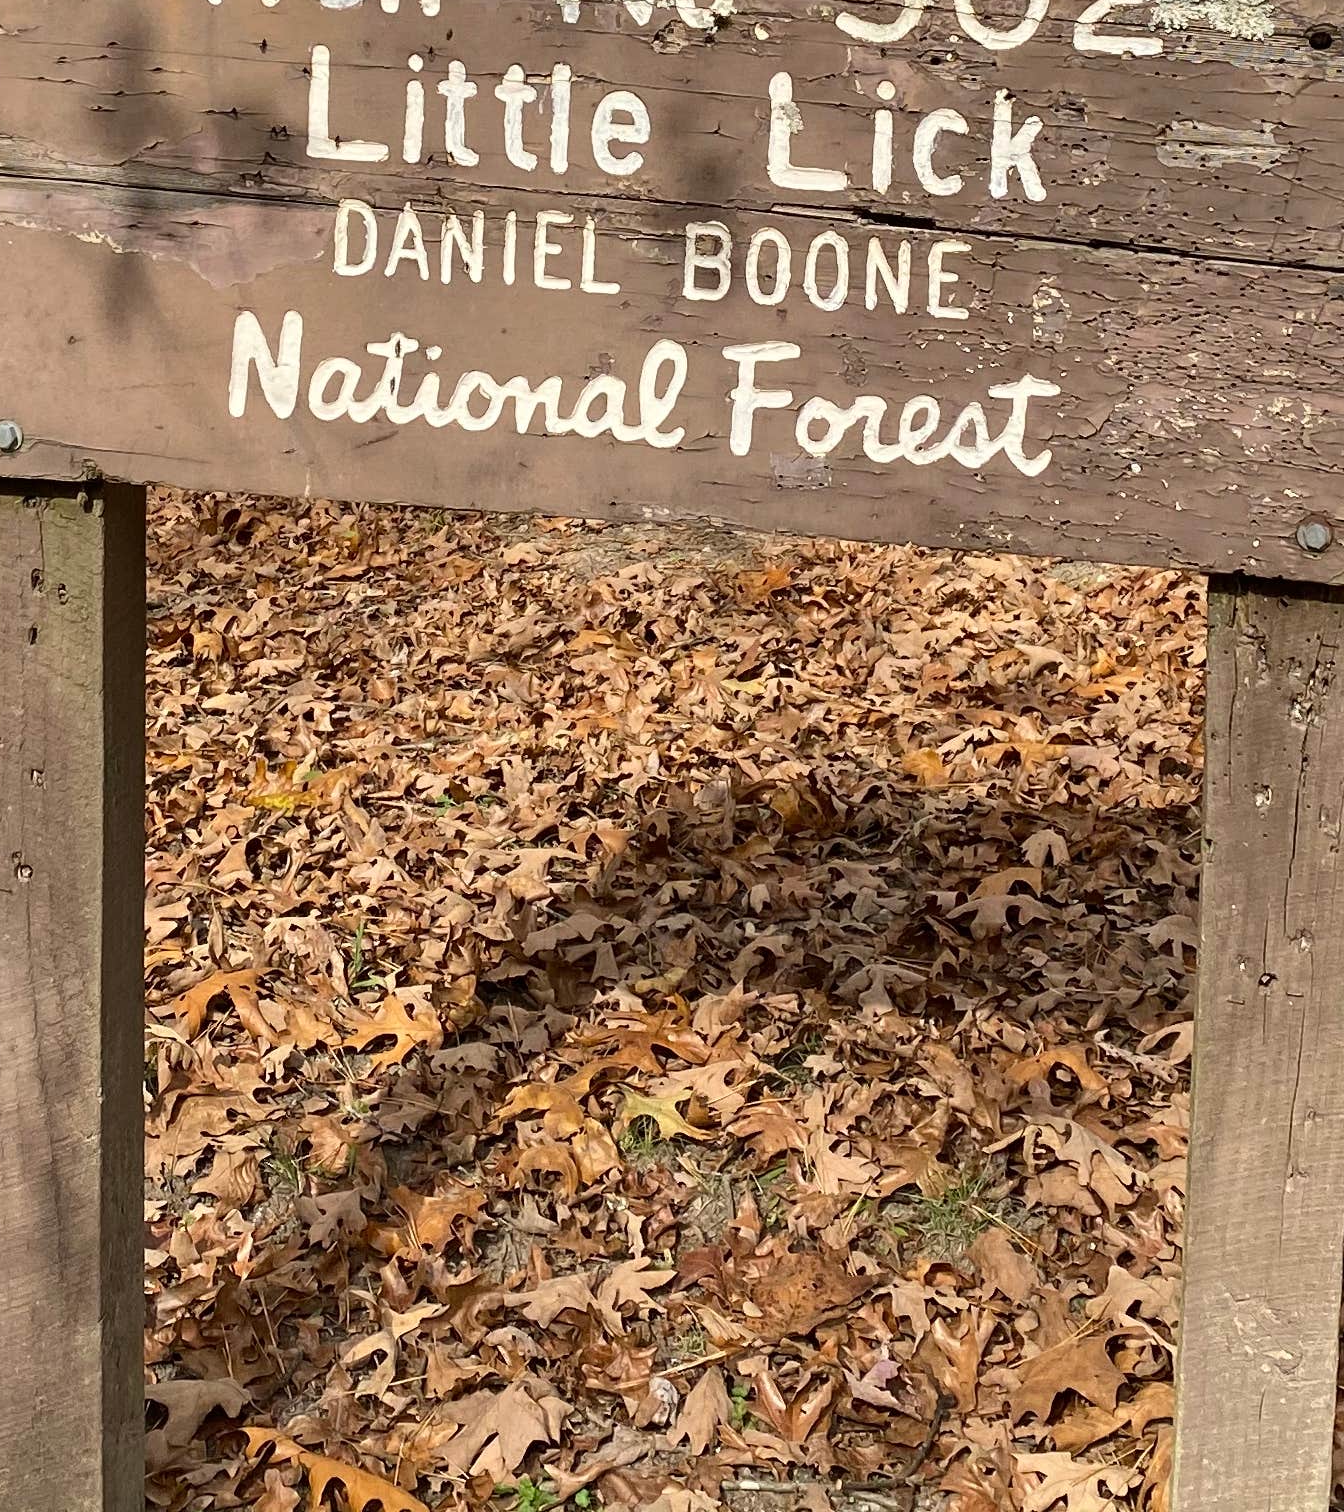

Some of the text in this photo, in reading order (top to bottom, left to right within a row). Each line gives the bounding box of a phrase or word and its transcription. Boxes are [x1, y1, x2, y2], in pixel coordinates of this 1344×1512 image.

[306, 44, 1047, 202] Little Lick
[332, 199, 973, 320] DANIEL BOONE
[227, 310, 1061, 476] National Forest
